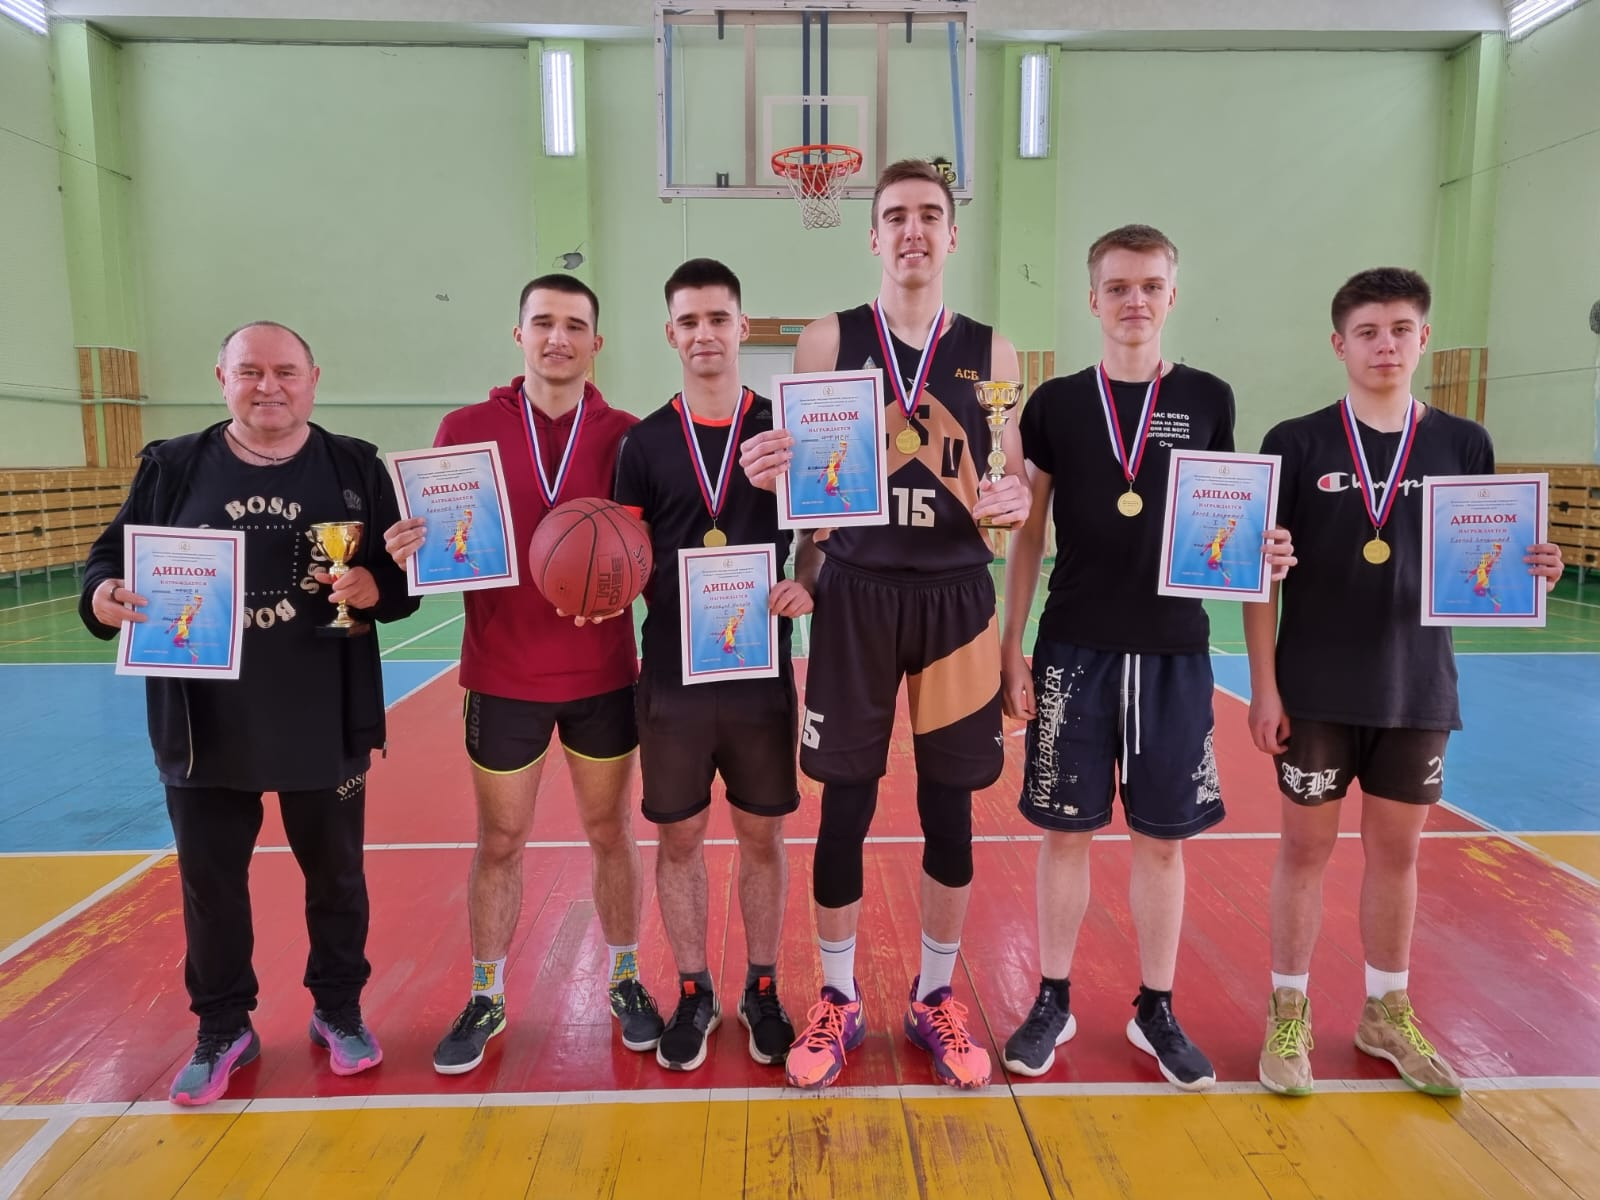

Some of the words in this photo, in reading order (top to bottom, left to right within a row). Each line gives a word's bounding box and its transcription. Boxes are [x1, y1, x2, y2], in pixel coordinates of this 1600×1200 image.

[801, 411, 859, 424] ДИПЛОМ
[1167, 412, 1190, 421] ВСЕГО
[1147, 431, 1190, 440] ОГОВОРИТЬСЯ
[422, 481, 480, 497] ДИПЛОМ
[1192, 489, 1252, 501] ДИПЛОМ
[225, 496, 301, 520] BOSS
[892, 487, 936, 528] 15
[1451, 514, 1517, 526] ДИПЛОМ
[152, 566, 216, 577] ДИПЛОМ
[703, 581, 755, 594] ДИПЛОМ
[803, 704, 825, 750] 5
